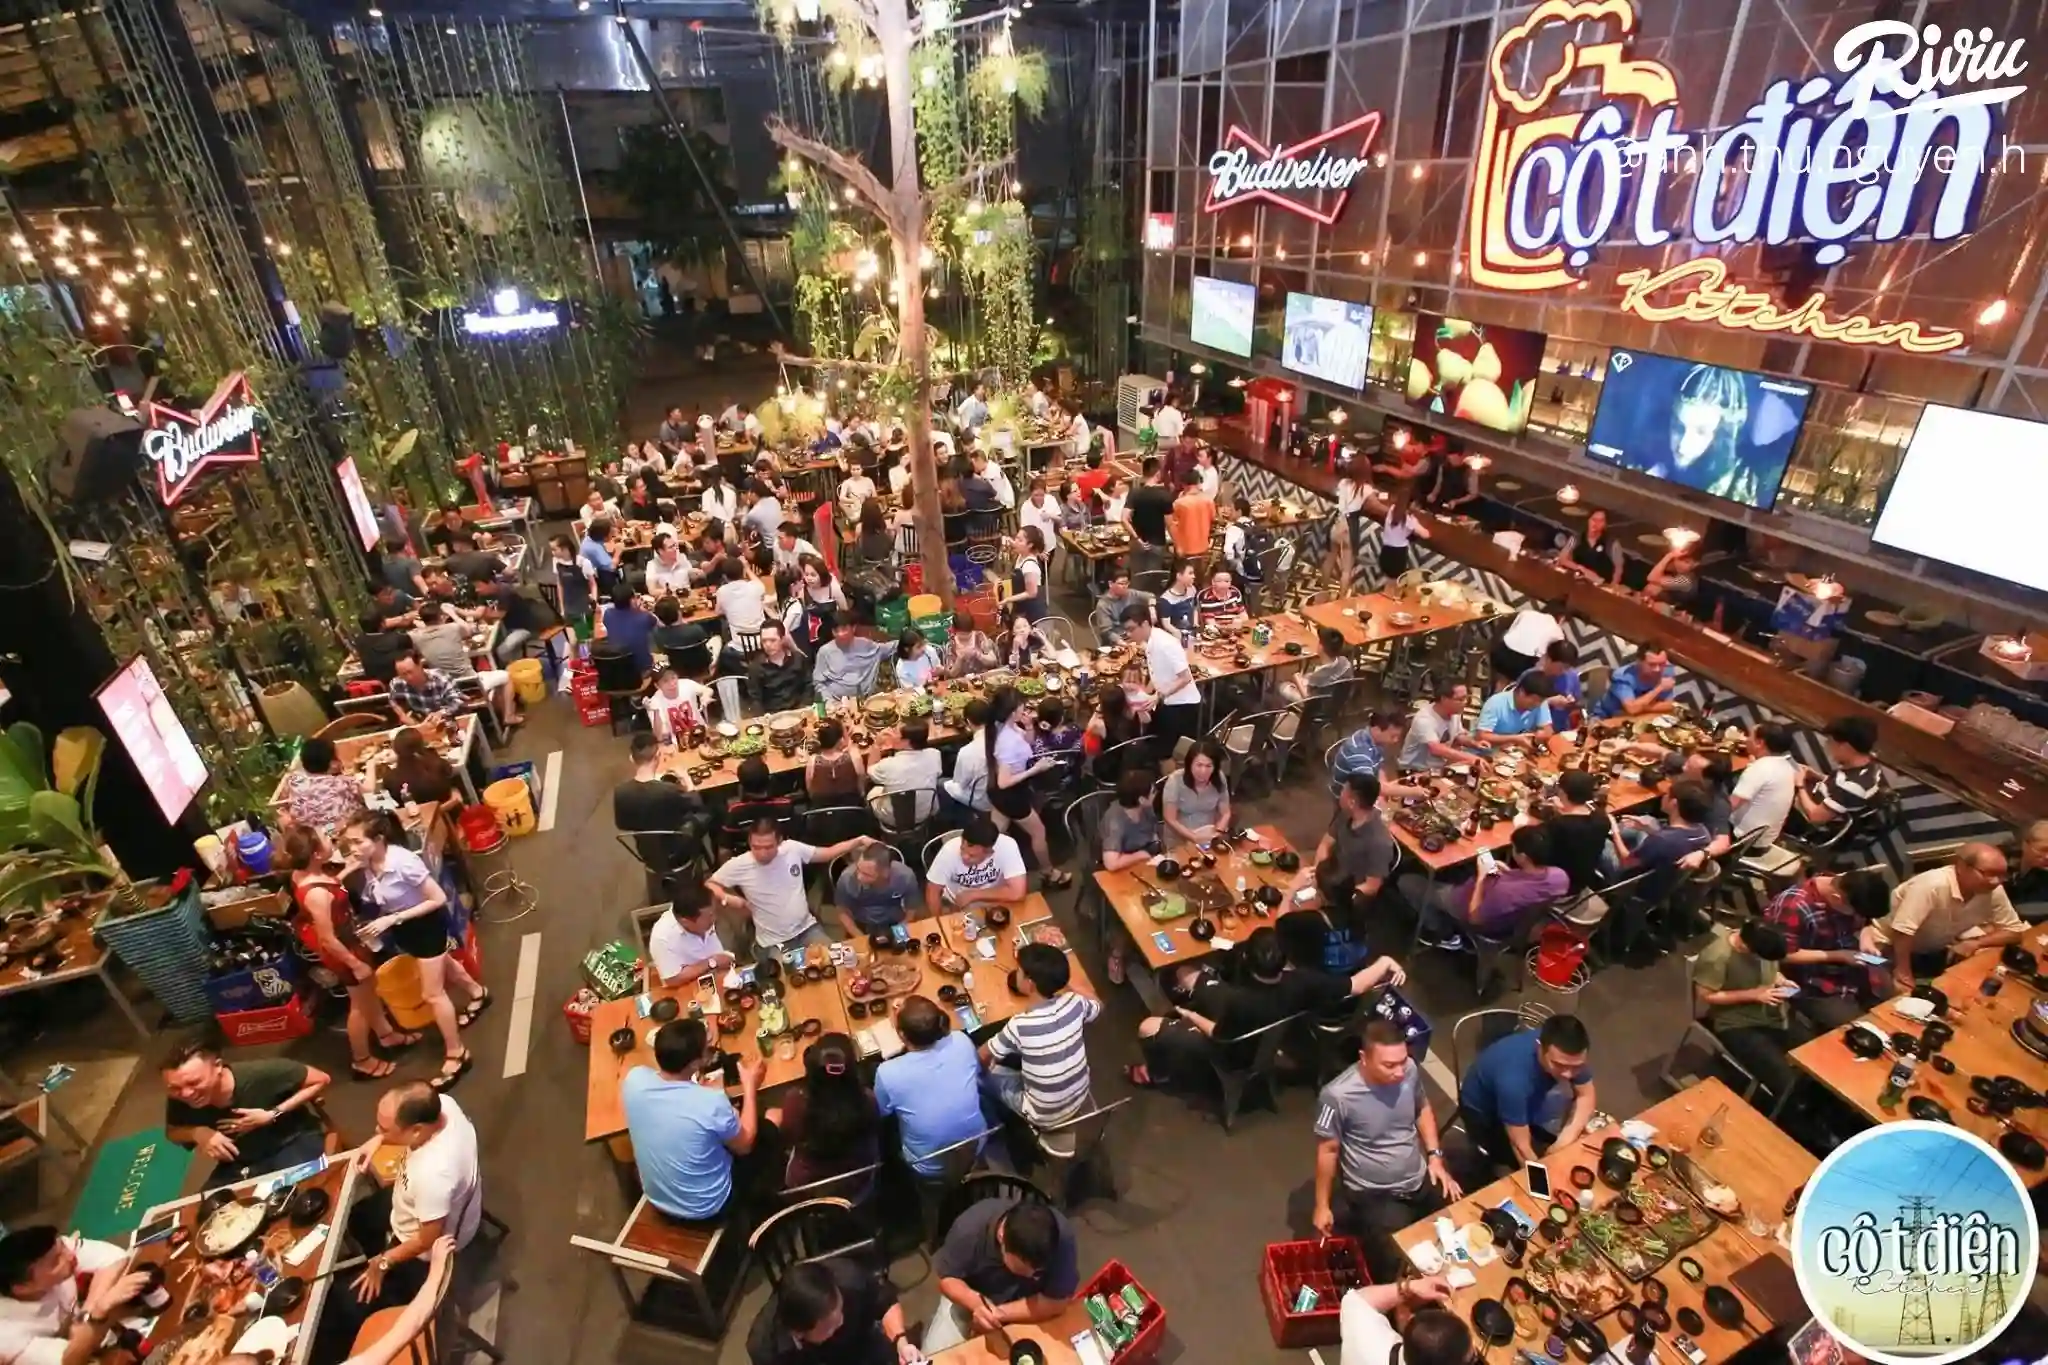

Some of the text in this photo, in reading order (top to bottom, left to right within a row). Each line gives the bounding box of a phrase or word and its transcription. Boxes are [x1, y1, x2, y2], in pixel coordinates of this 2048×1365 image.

[1209, 144, 1368, 197] Budweiser
[1511, 60, 1990, 265] cột điện
[1617, 257, 1963, 352] Kitchen
[114, 1143, 157, 1215] WELCOME
